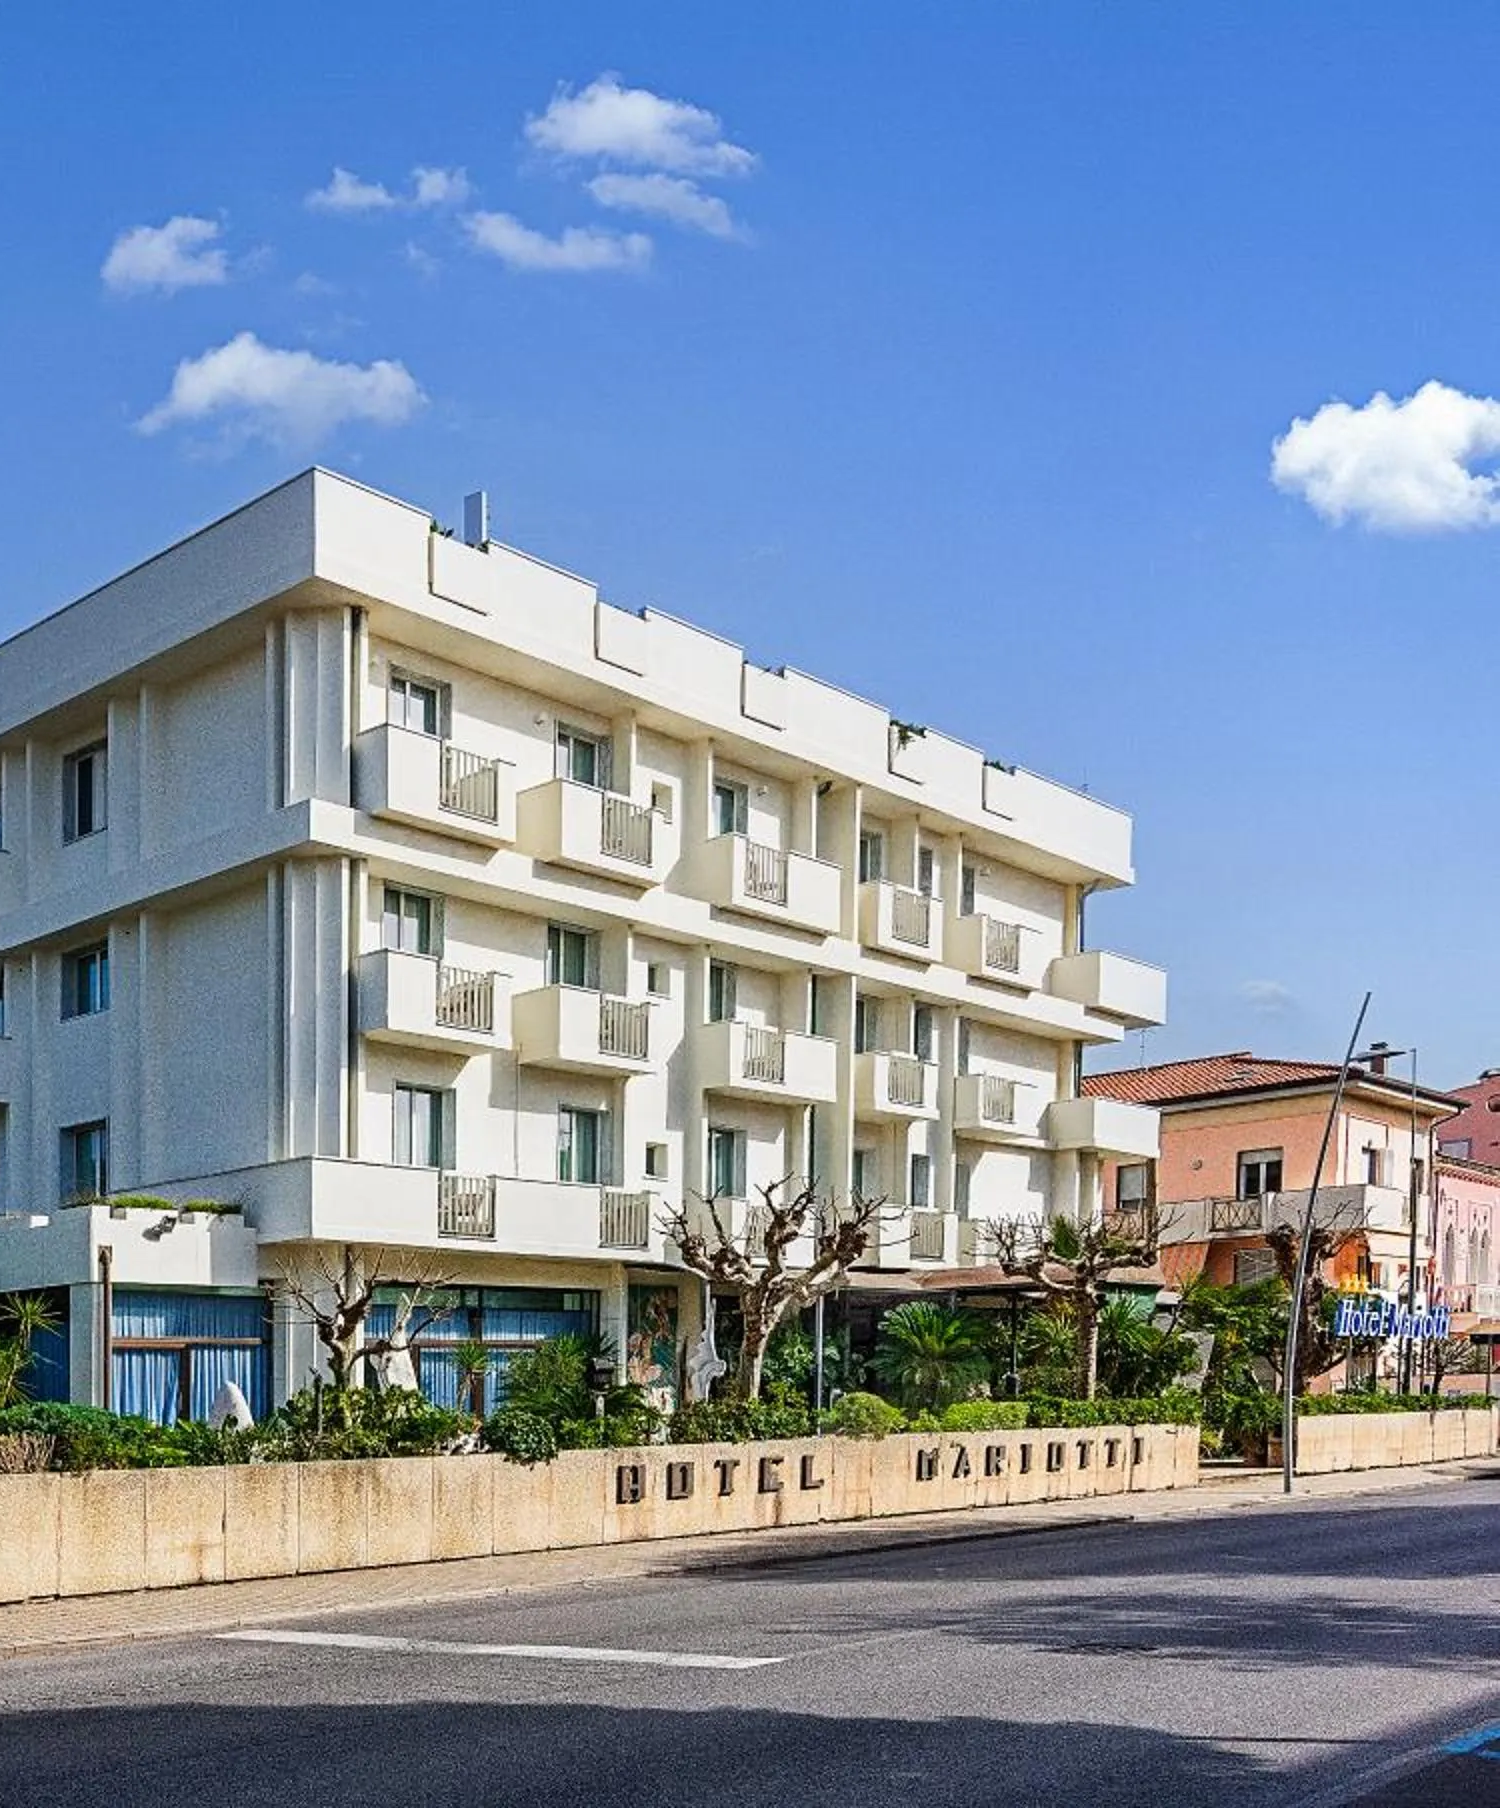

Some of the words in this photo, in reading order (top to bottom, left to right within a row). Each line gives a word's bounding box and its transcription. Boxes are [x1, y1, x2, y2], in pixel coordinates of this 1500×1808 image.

[1338, 1299, 1389, 1337] Hotel
[616, 1455, 825, 1504] HOTEL
[916, 1436, 1145, 1481] MARIOTTI
